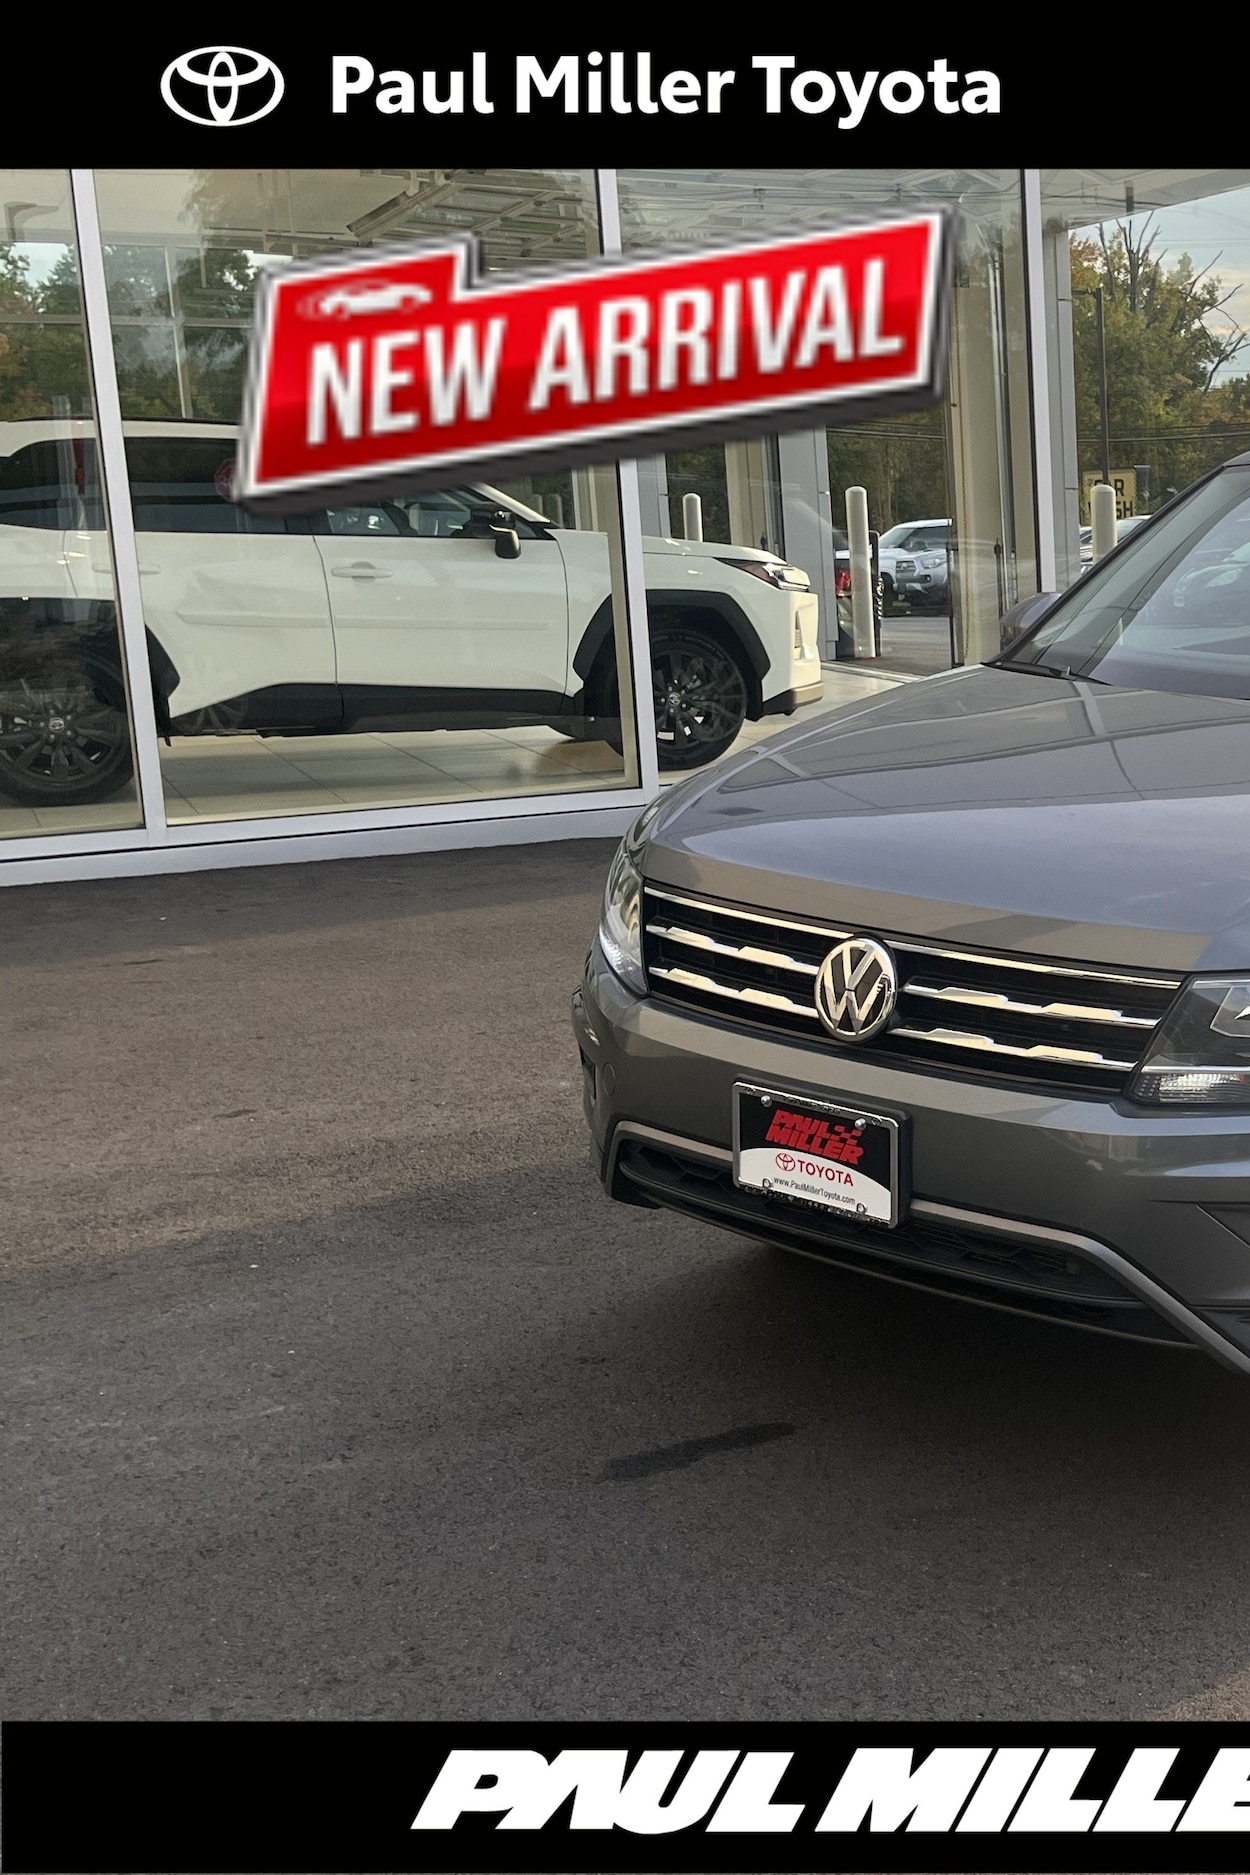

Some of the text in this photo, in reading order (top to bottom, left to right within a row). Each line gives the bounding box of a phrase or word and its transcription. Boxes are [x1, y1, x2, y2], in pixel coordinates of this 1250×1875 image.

[772, 1109, 831, 1139] PAUL
[764, 1123, 864, 1165] MILLER
[797, 1159, 854, 1187] TOYOTA
[773, 1175, 856, 1205] www.PaulMillerToyota.com
